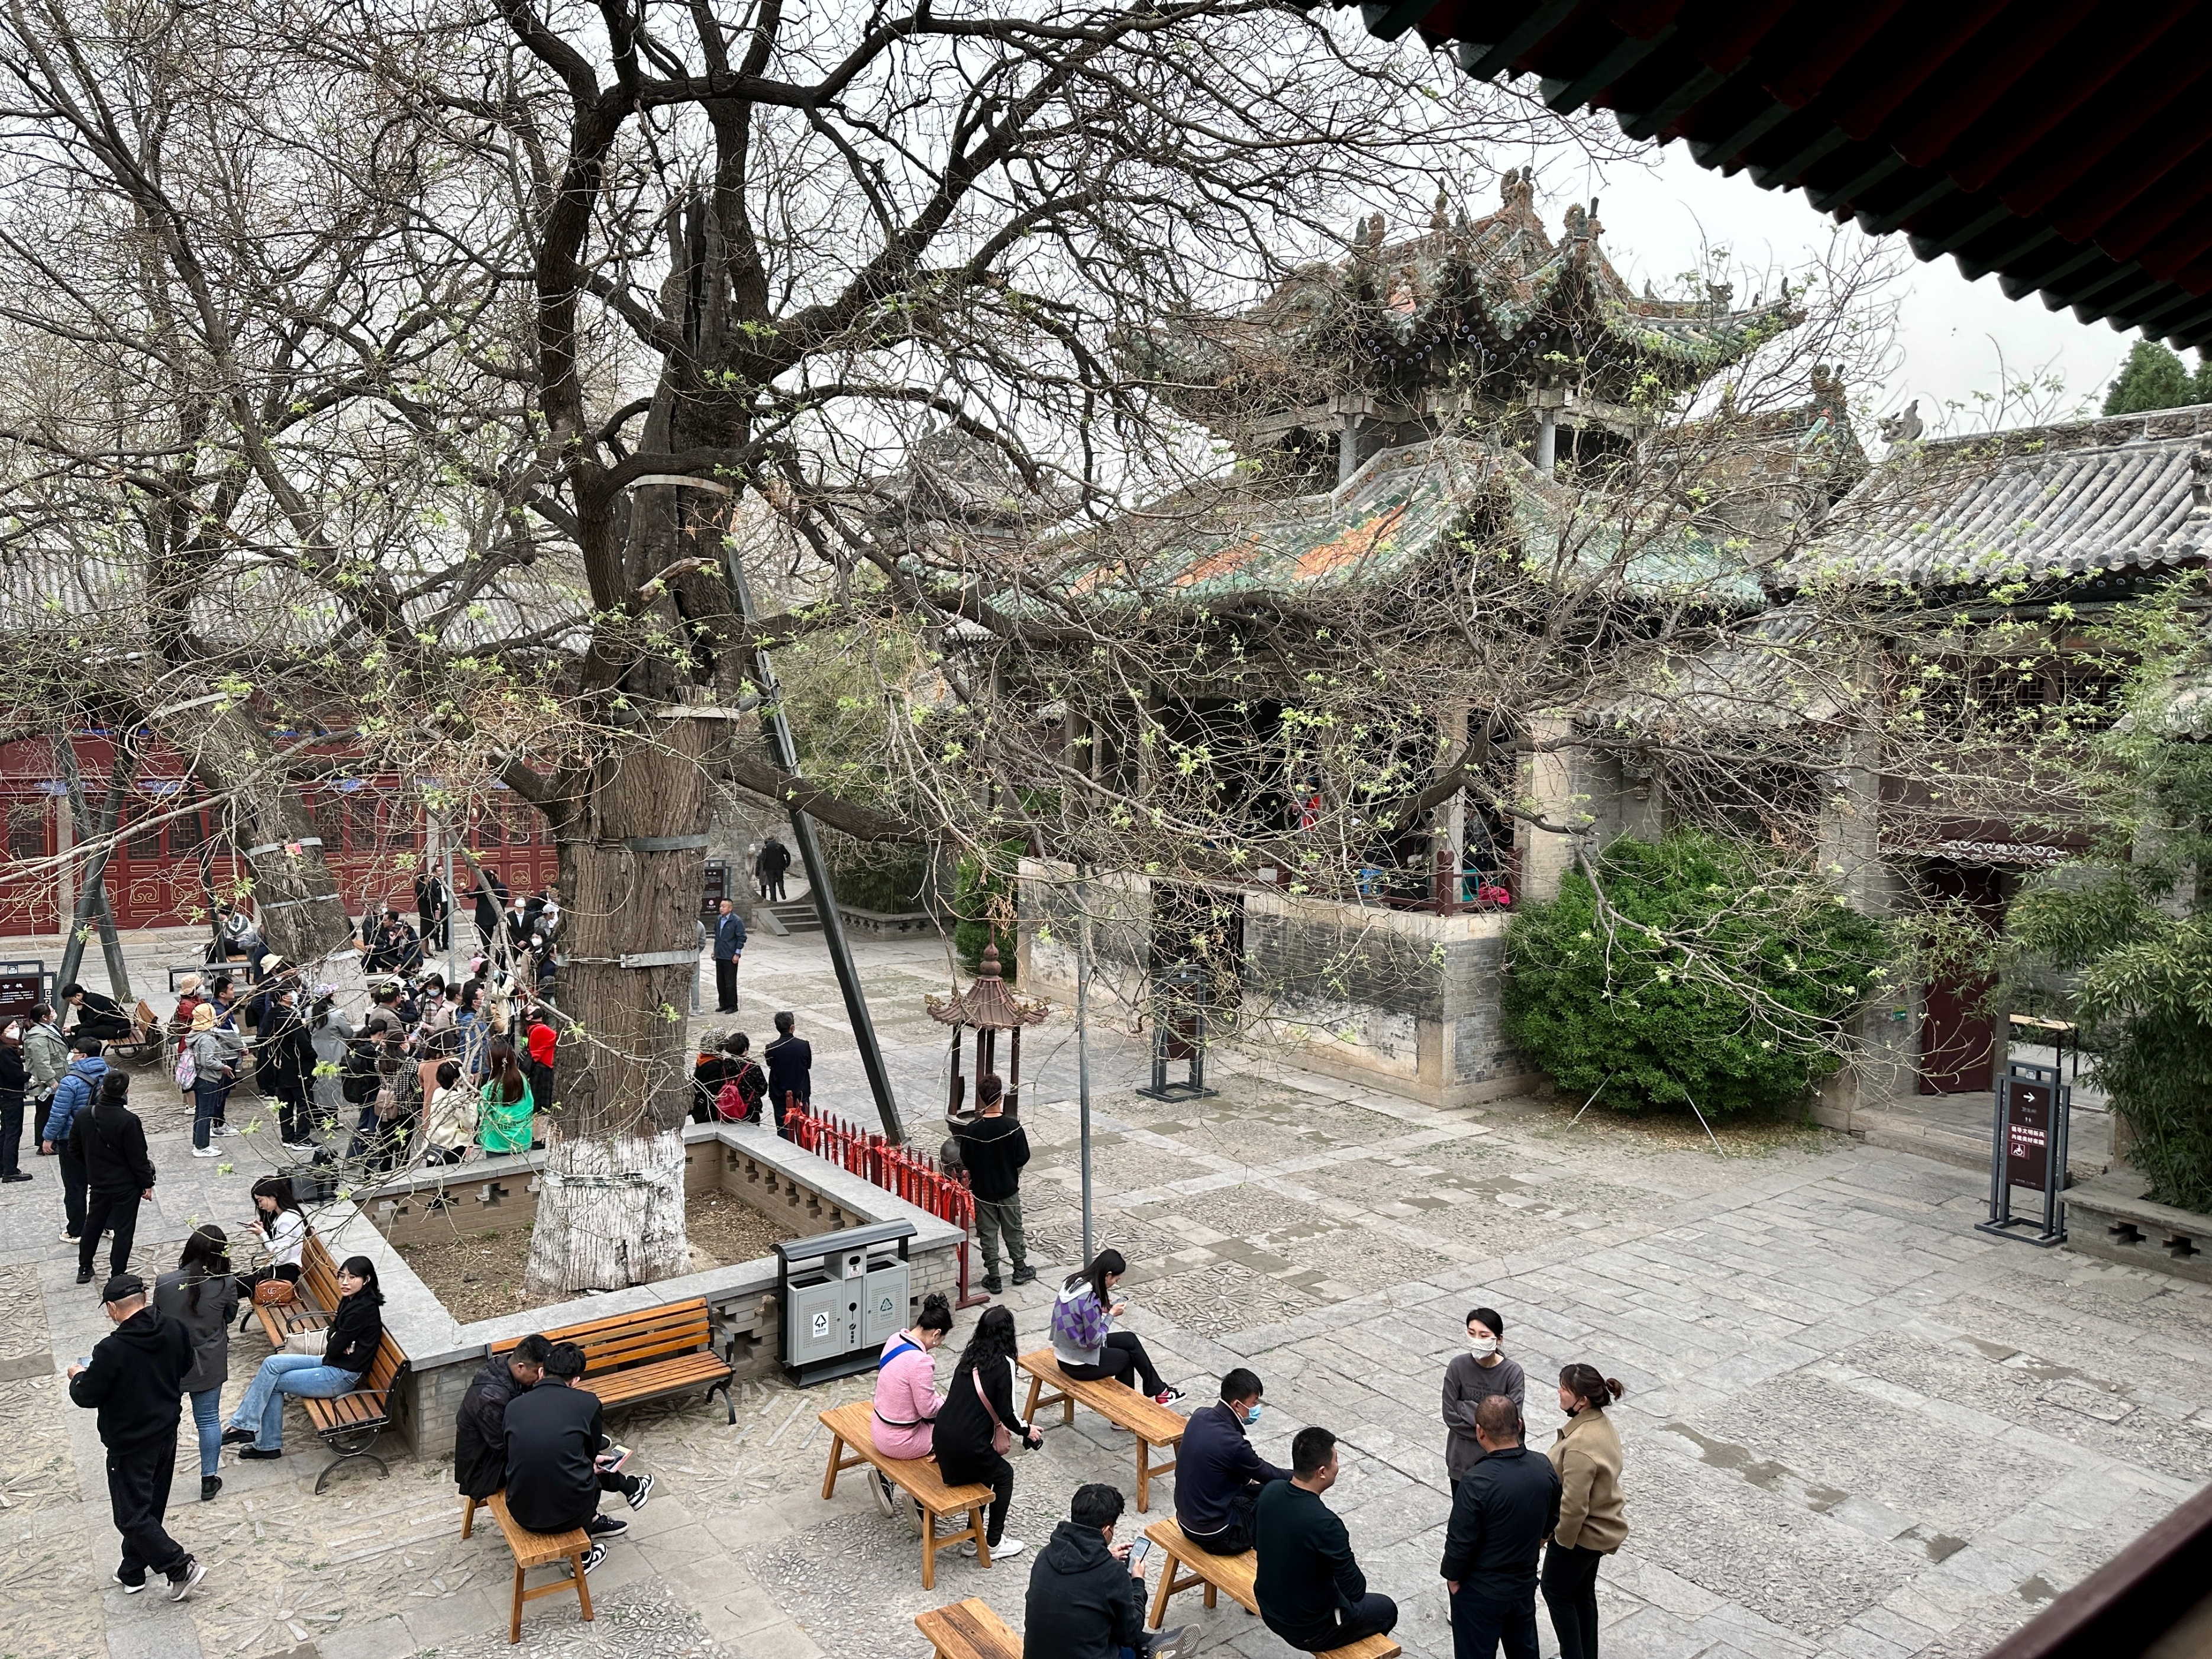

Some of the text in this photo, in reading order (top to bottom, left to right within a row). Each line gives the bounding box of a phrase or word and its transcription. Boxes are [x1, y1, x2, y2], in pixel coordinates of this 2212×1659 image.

[2011, 1126, 2045, 1138] 倡导文明新风
[2011, 1134, 2045, 1145] 共建美好家园
